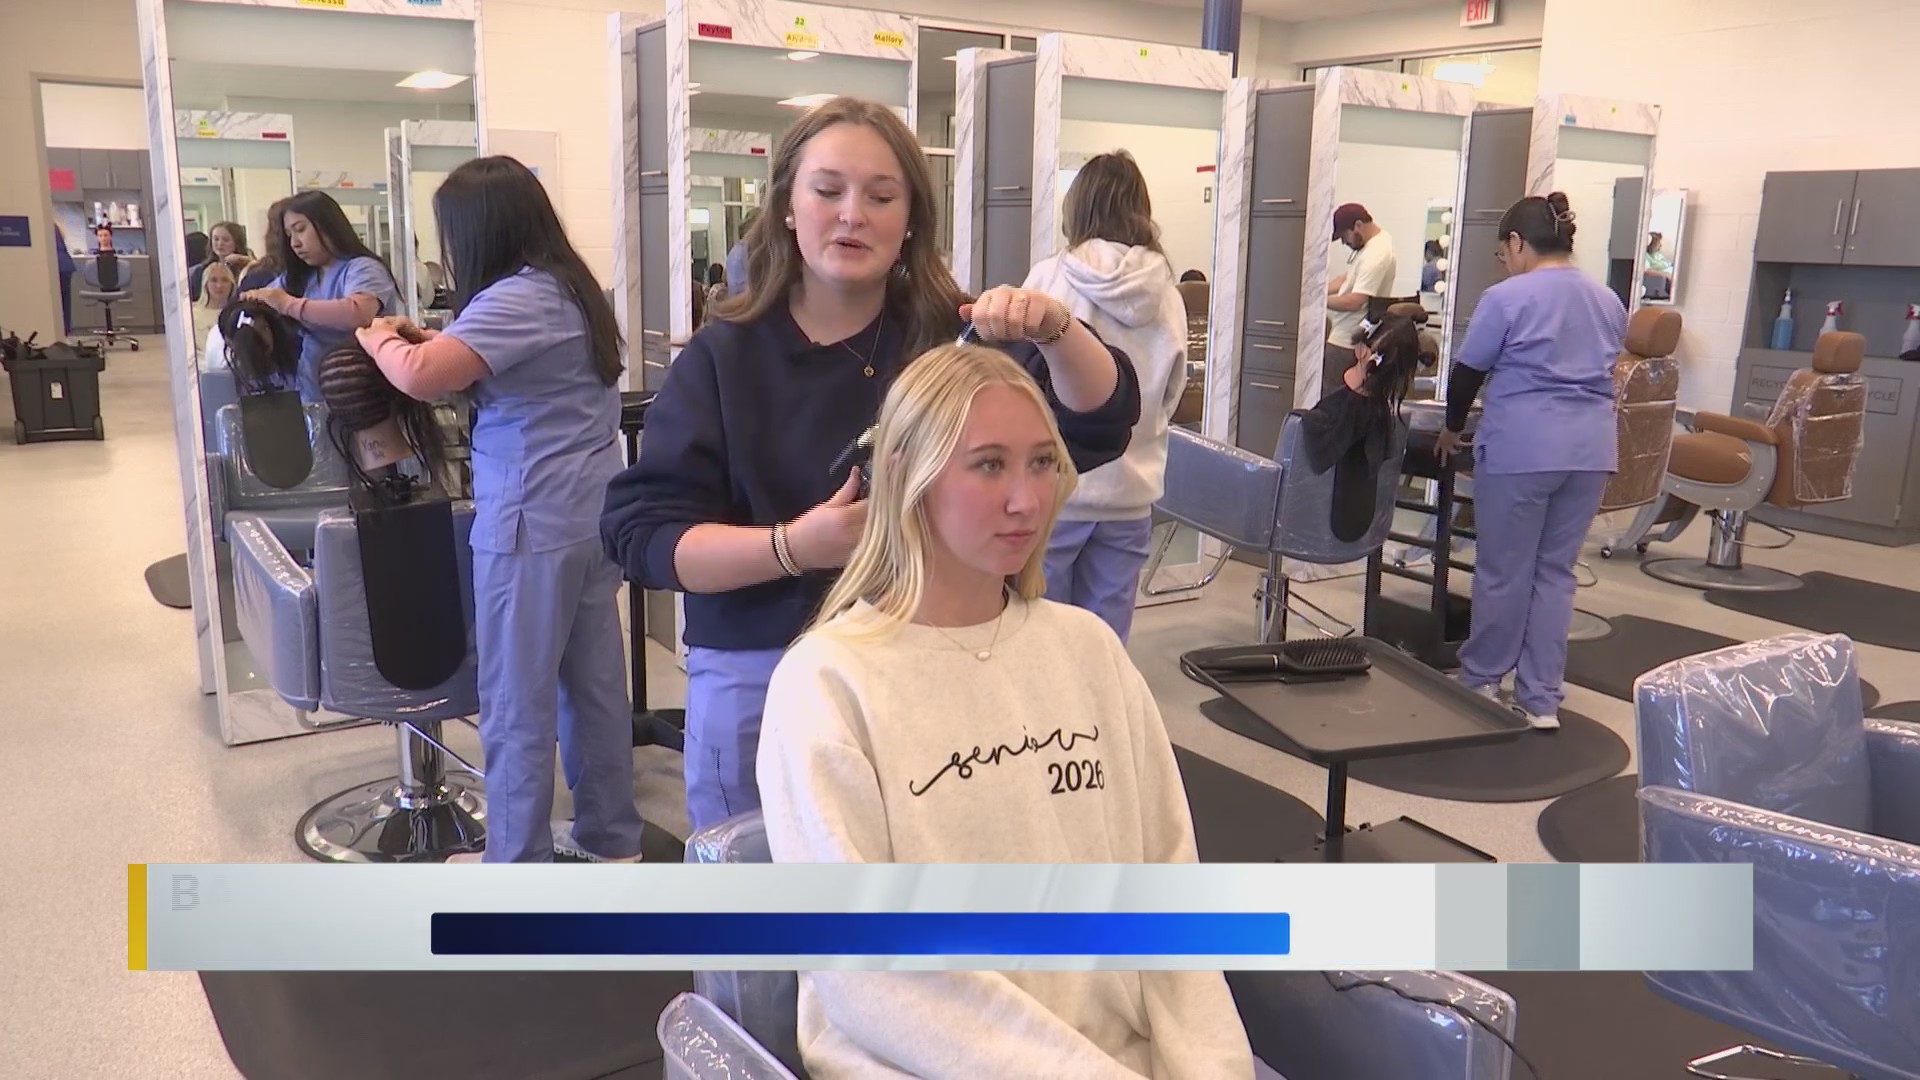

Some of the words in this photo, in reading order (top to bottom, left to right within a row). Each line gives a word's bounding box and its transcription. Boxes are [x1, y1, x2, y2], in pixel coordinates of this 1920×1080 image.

[1466, 0, 1489, 22] EXIT
[874, 33, 903, 46] Mallory
[909, 725, 1099, 796] senior
[1048, 759, 1105, 794] 2026
